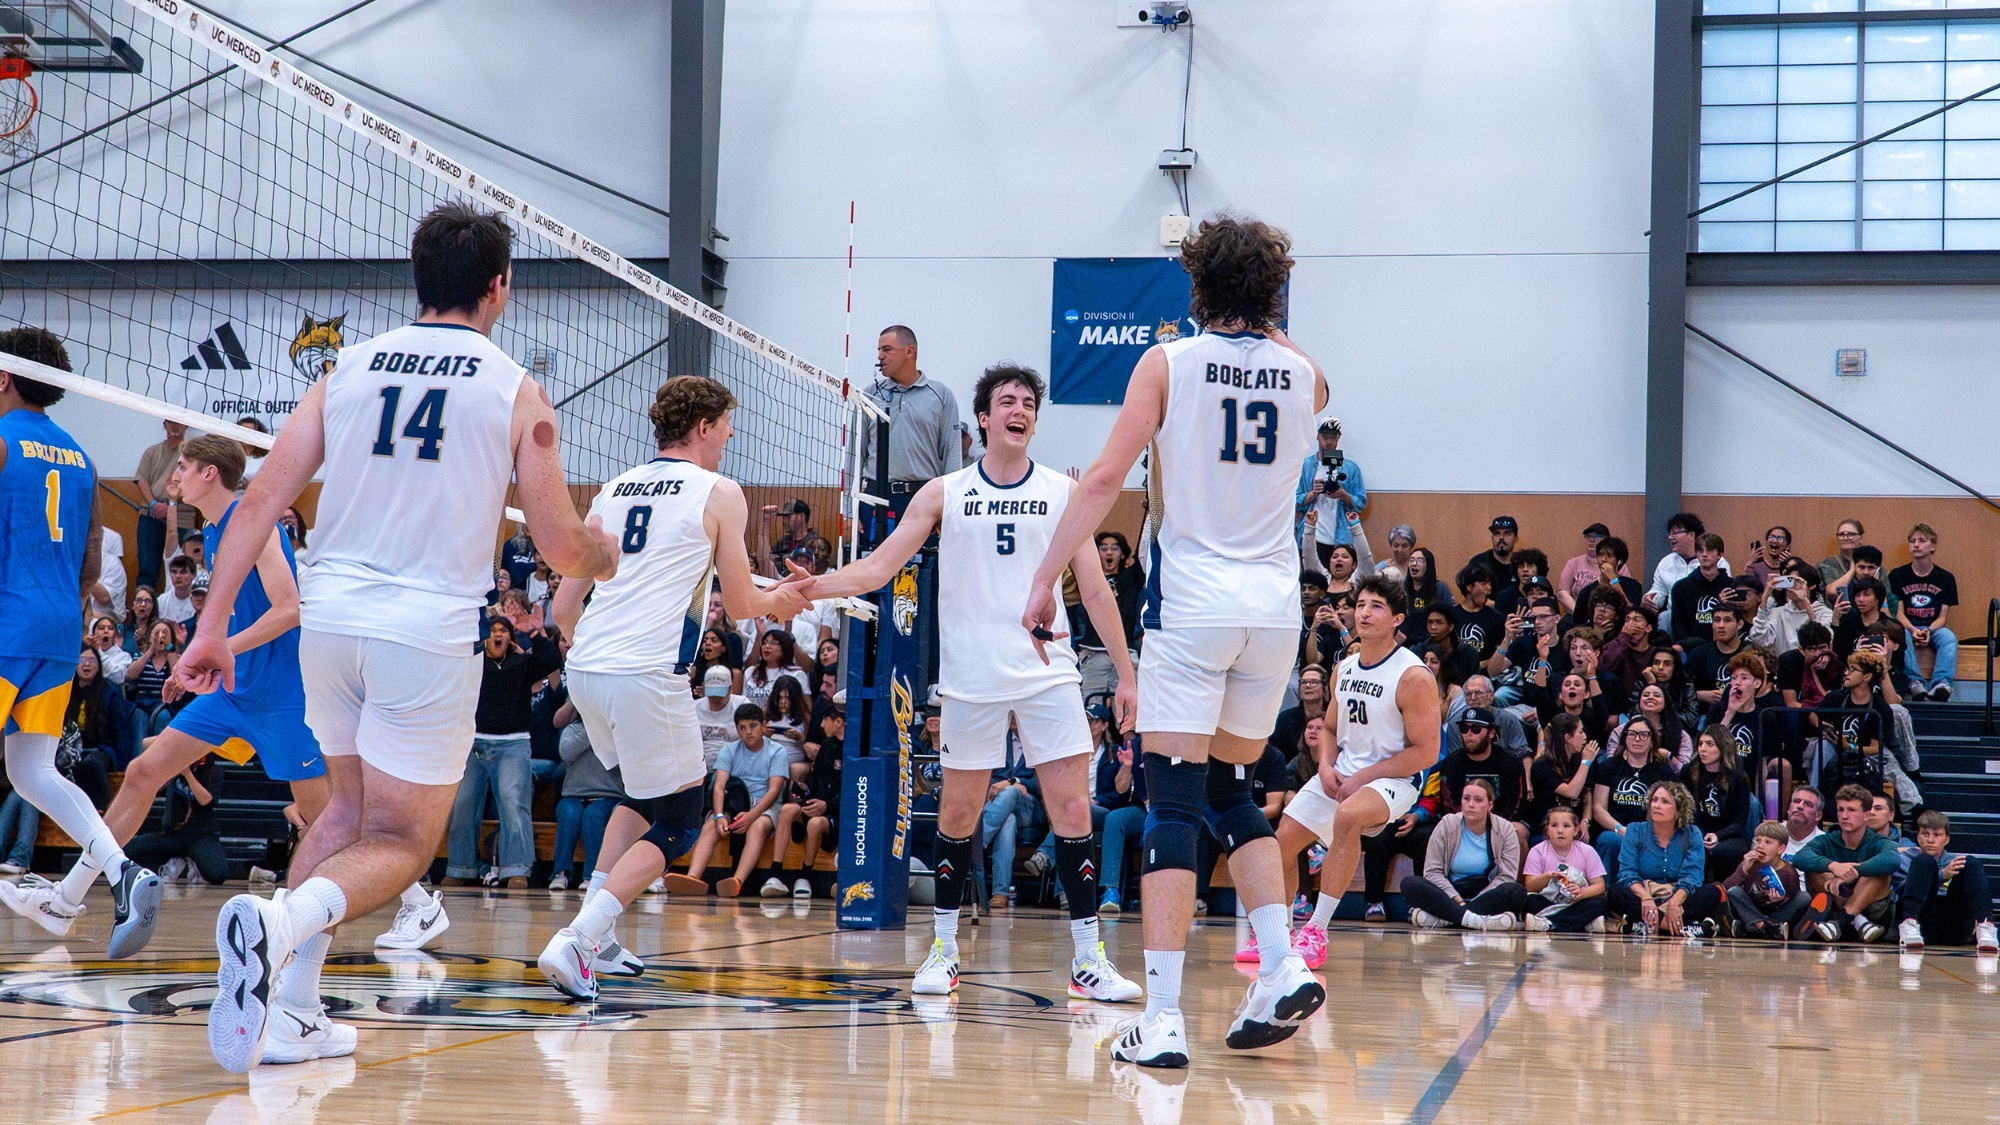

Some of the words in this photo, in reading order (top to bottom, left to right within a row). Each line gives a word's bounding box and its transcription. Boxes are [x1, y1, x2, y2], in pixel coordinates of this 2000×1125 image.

[147, 0, 178, 15] CED
[211, 25, 225, 43] UC
[226, 33, 261, 64] MERCED
[292, 72, 303, 88] UC
[304, 80, 335, 107] MERCED
[362, 113, 374, 129] UC
[374, 119, 402, 145] MERCED
[425, 150, 436, 165] UC
[435, 156, 462, 179] MERCED
[483, 183, 491, 197] UC
[491, 188, 516, 209] MERCED
[543, 217, 565, 238] MERCED
[590, 245, 611, 262] MERCED
[1083, 312, 1126, 321] DIVISION
[1129, 312, 1135, 320] II
[1079, 325, 1151, 345] MAKE
[368, 351, 483, 378] BOBCATS
[1205, 362, 1292, 391] BOBCATS
[212, 400, 261, 414] OFFICIAL
[371, 384, 450, 463] 14
[1218, 396, 1280, 466] 13
[19, 440, 86, 469] BRUINS
[612, 479, 685, 498] BOBCATS
[45, 469, 64, 542] 1
[964, 501, 983, 516] UC
[987, 500, 1048, 516] MERCED
[622, 503, 654, 555] 8
[996, 522, 1016, 556] 5
[1339, 678, 1350, 692] UC
[1350, 679, 1384, 698] MERCED
[1347, 698, 1368, 725] 20
[858, 776, 868, 816] sports
[855, 818, 868, 866] imports
